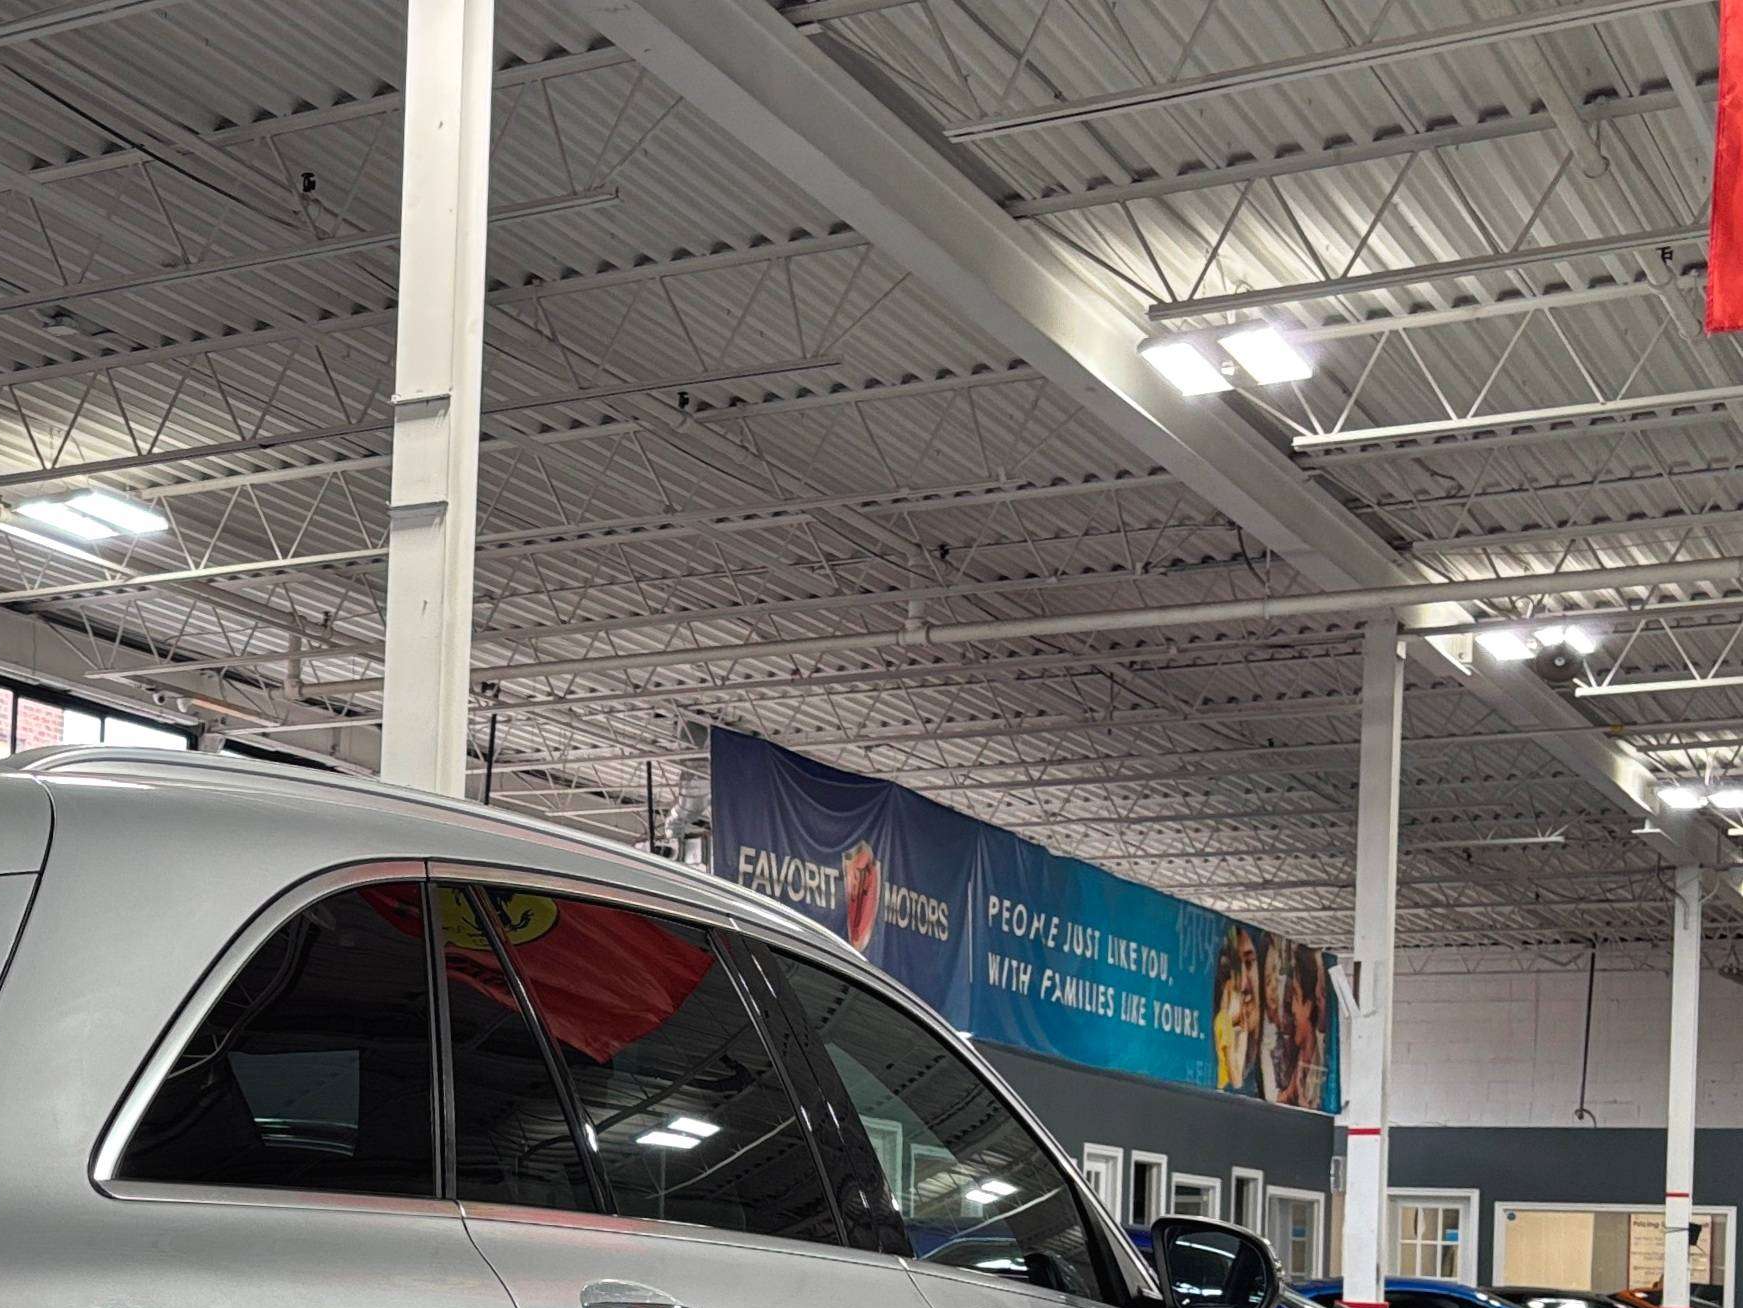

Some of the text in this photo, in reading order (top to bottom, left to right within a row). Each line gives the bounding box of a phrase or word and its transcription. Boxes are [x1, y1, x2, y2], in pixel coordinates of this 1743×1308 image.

[738, 845, 949, 942] FAVORIT MOTORS
[1063, 922, 1101, 960] JUST
[1107, 934, 1138, 972] LIKE
[987, 952, 1206, 1040] WITH FAMILIES LIKE YOURS.
